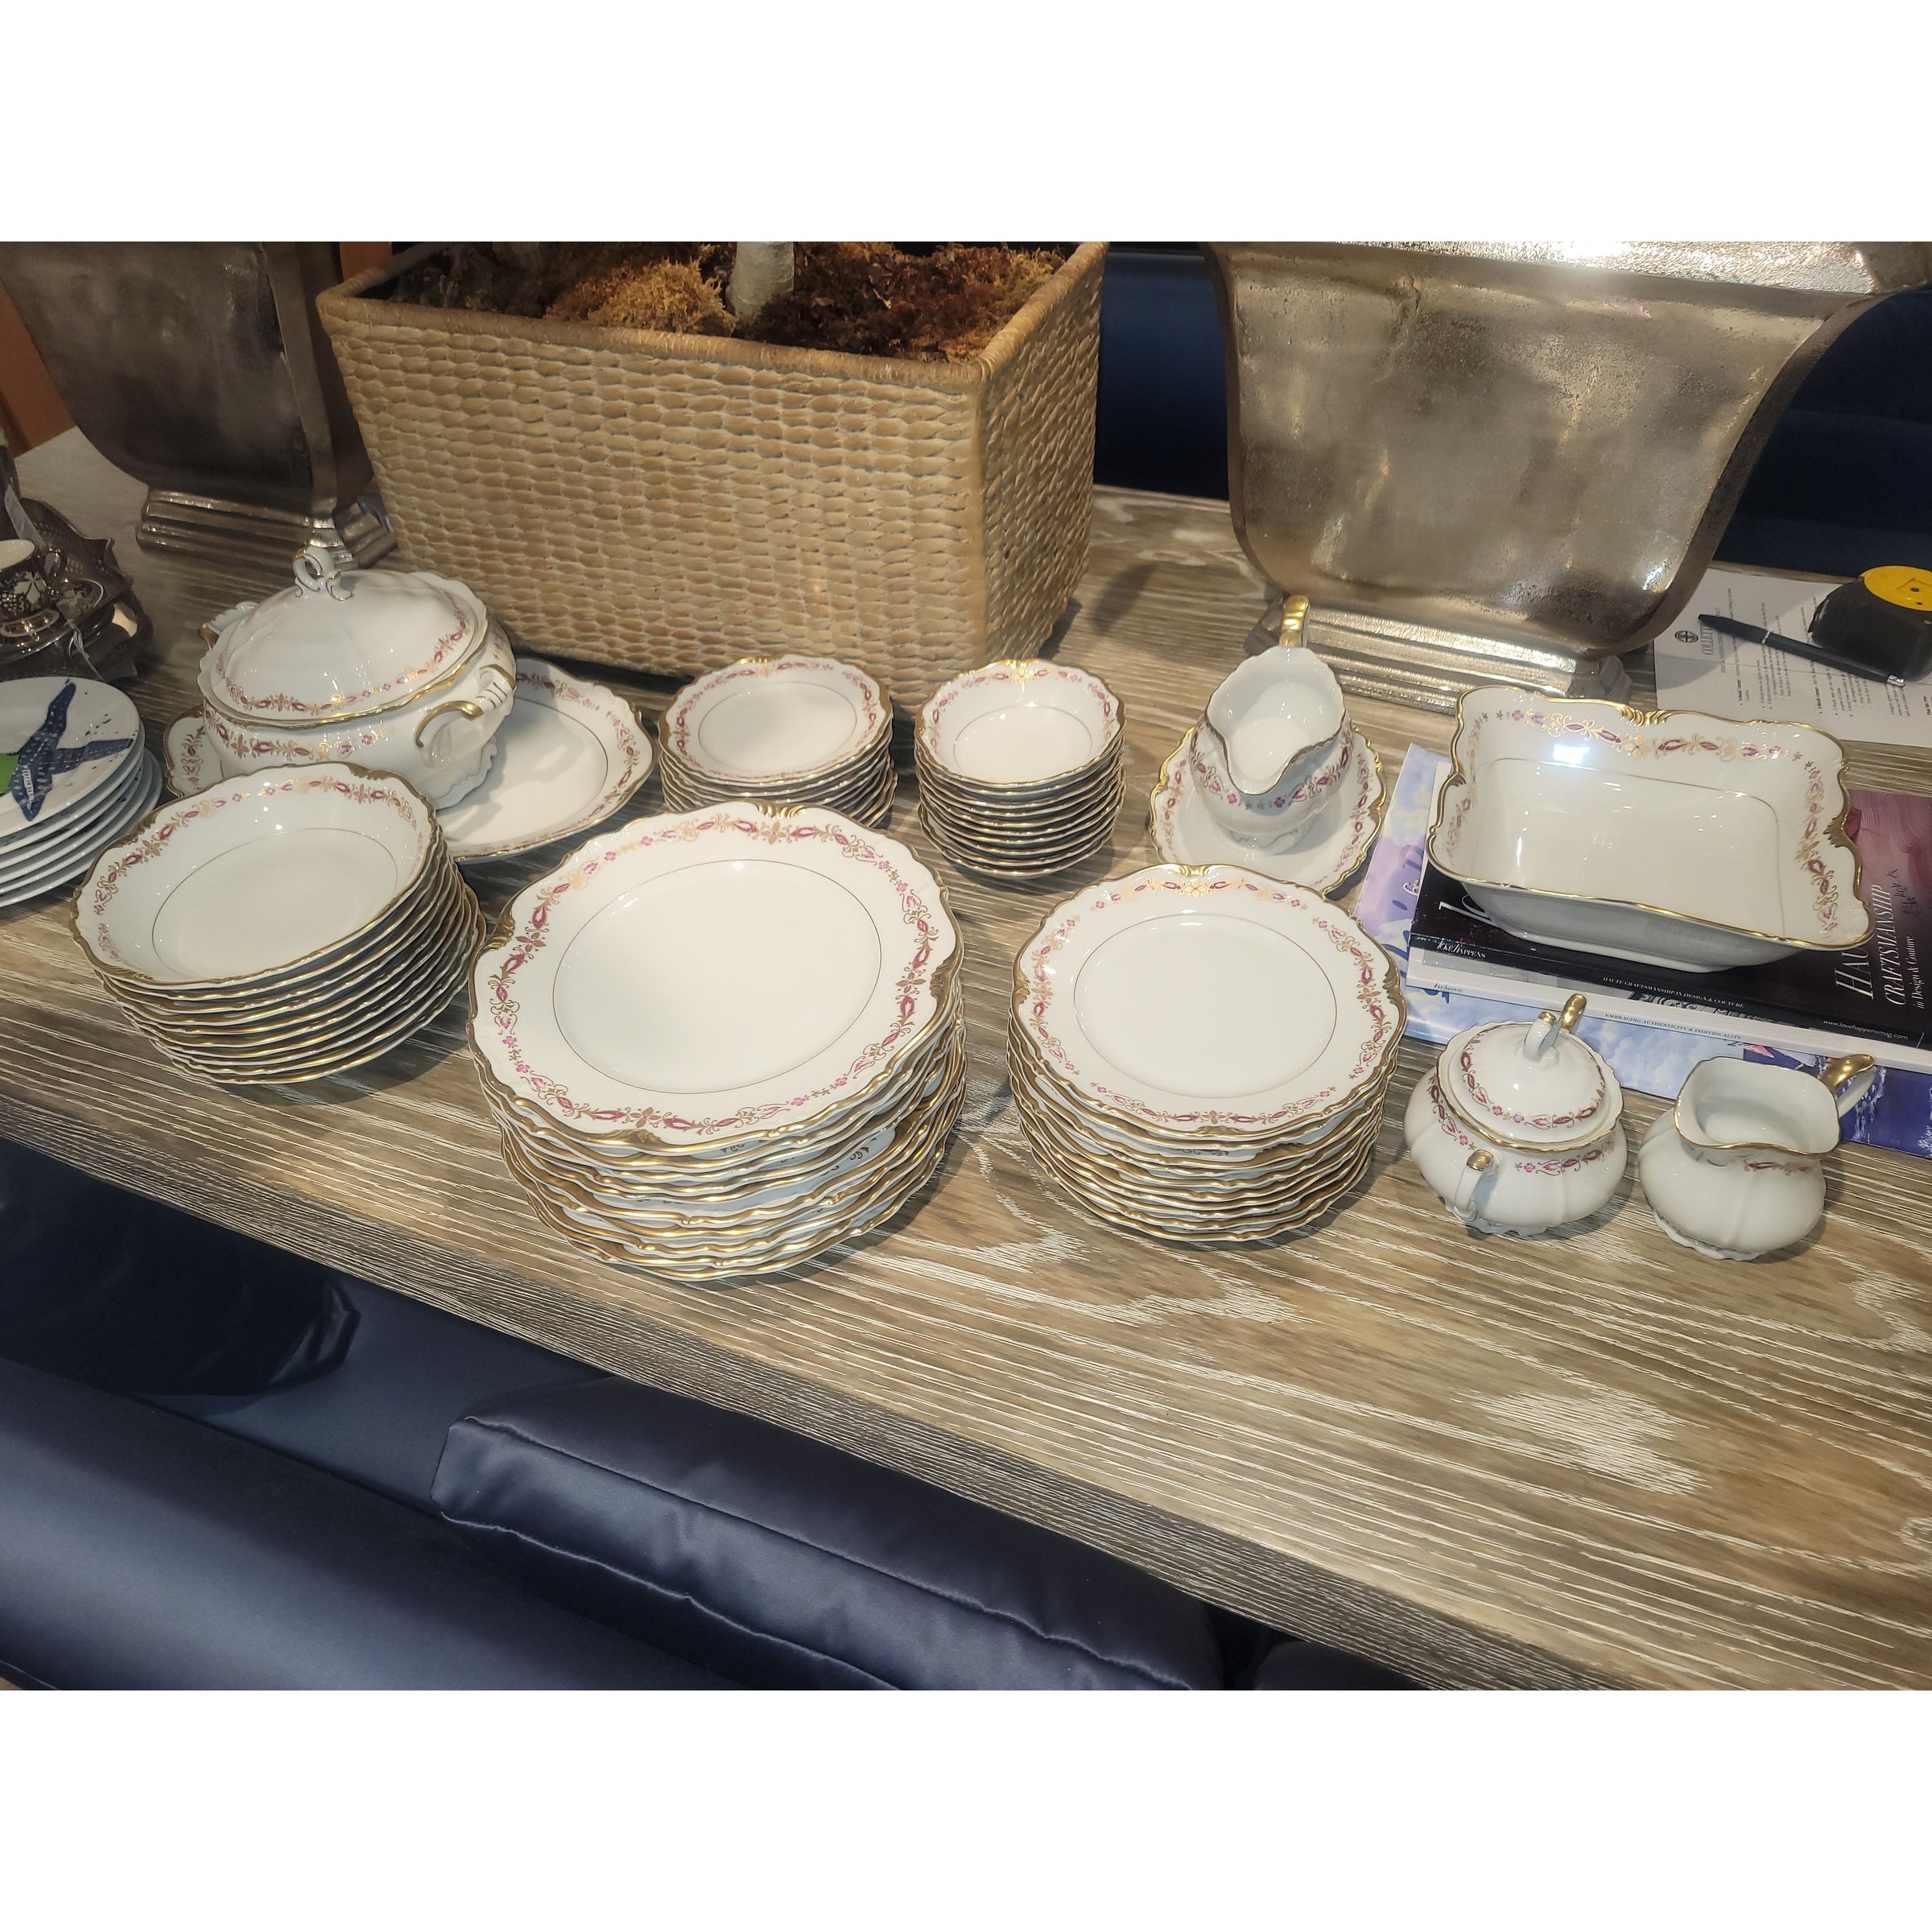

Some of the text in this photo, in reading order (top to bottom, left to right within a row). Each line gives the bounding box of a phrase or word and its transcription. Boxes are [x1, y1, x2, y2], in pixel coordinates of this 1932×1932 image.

[1700, 621, 1715, 655] COLLETT
[1871, 884, 1907, 1005] CRAFTSMANSHIP
[1905, 935, 1918, 964] Couture
[1835, 947, 1874, 1000] HAU
[1909, 974, 1925, 1001] Design
[1603, 976, 1623, 985] HAUTE
[1624, 981, 1675, 995] CRAFTSMANSHIP
[1683, 993, 1707, 1001] DESIGN
[1714, 999, 1744, 1009] COUTURE
[1912, 1001, 1925, 1009] in
[1605, 1013, 1641, 1023] EMBRACING
[1643, 1019, 1687, 1031] AUTHENTICITY
[1695, 1029, 1740, 1039] INDIVIDUALITY
[1823, 1019, 1909, 1040] www.lovehappensmag.com
